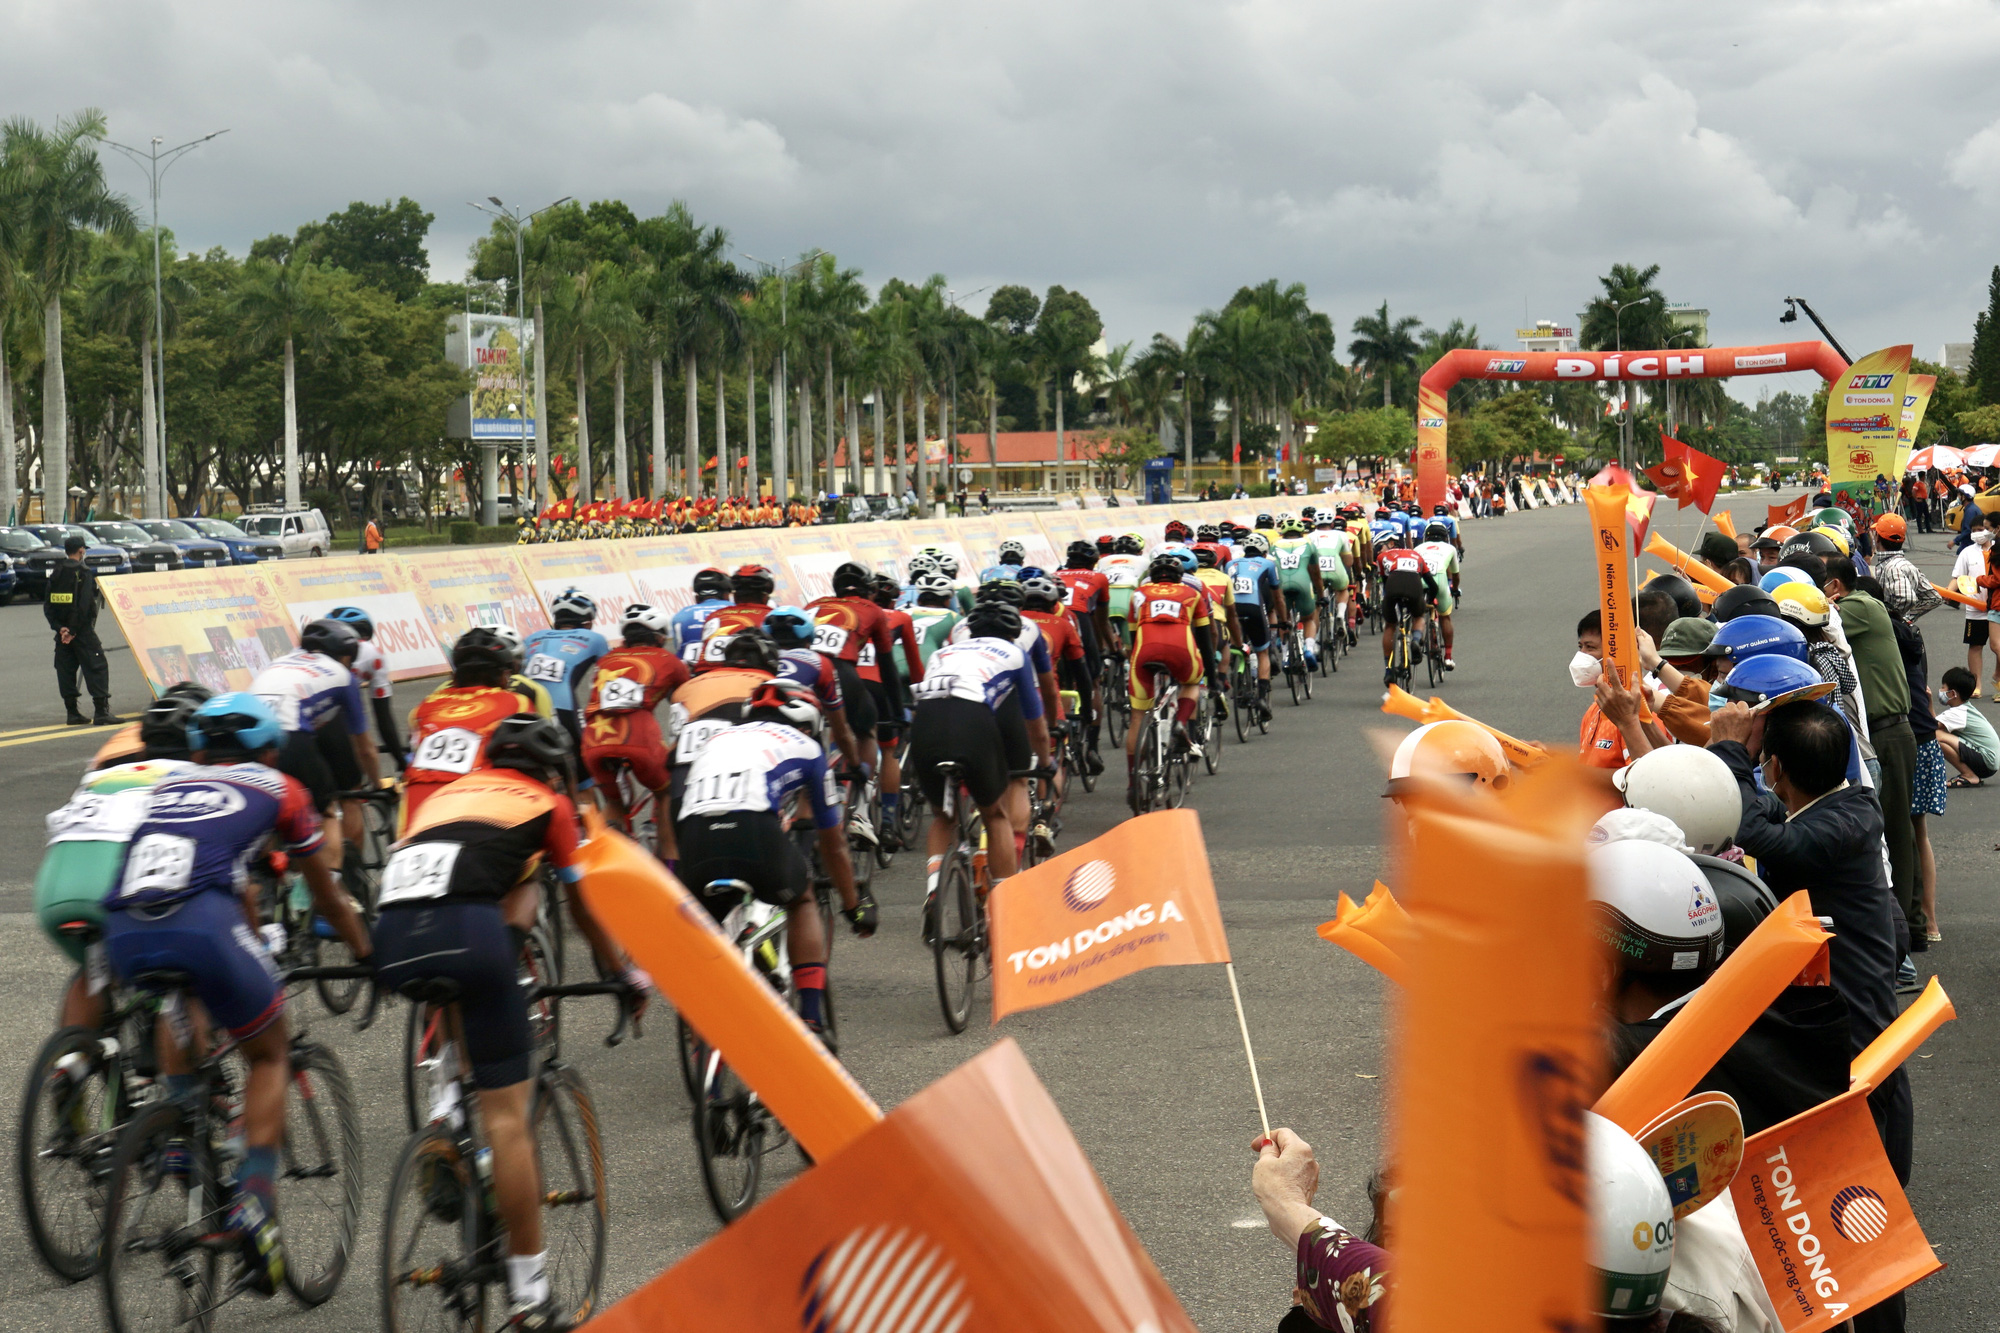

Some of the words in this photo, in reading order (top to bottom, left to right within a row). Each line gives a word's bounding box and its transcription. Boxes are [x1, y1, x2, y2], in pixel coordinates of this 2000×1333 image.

[1554, 327, 1573, 337] HOTEL
[1486, 360, 1525, 373] HTV
[1554, 354, 1704, 378] ĐÍCH
[1745, 359, 1758, 367] TON
[1759, 357, 1778, 366] DONG
[1778, 356, 1784, 364] A
[1850, 375, 1893, 388] HTV
[1420, 419, 1444, 427] HTV
[1283, 555, 1298, 566] 33
[1320, 558, 1333, 568] 21
[1402, 559, 1416, 568] 76
[1234, 578, 1250, 591] 63
[1155, 602, 1175, 612] 91
[415, 618, 435, 648] A
[813, 628, 841, 648] 86
[1608, 633, 1619, 659] ngày
[1736, 643, 1750, 651] VNPT
[531, 656, 558, 678] 64
[607, 682, 637, 702] 84
[425, 734, 469, 764] 93
[1596, 740, 1614, 750] HTV
[695, 771, 743, 804] 117
[1688, 903, 1718, 920] SAGOPHAR
[1691, 917, 1707, 928] WHO
[1006, 936, 1071, 974] TON
[1074, 903, 1156, 955] DONG
[1158, 900, 1185, 924] A
[1660, 1158, 1675, 1175] VUI
[1676, 1177, 1688, 1193] HTV
[1766, 1145, 1802, 1211] TON
[1786, 1211, 1839, 1299] DONG
[1823, 1303, 1850, 1319] A
[1751, 1174, 1766, 1205] cùng
[1760, 1202, 1774, 1227] xây
[1768, 1226, 1788, 1257] cuộc
[1781, 1256, 1799, 1288] sống
[1793, 1287, 1815, 1318] xanh
